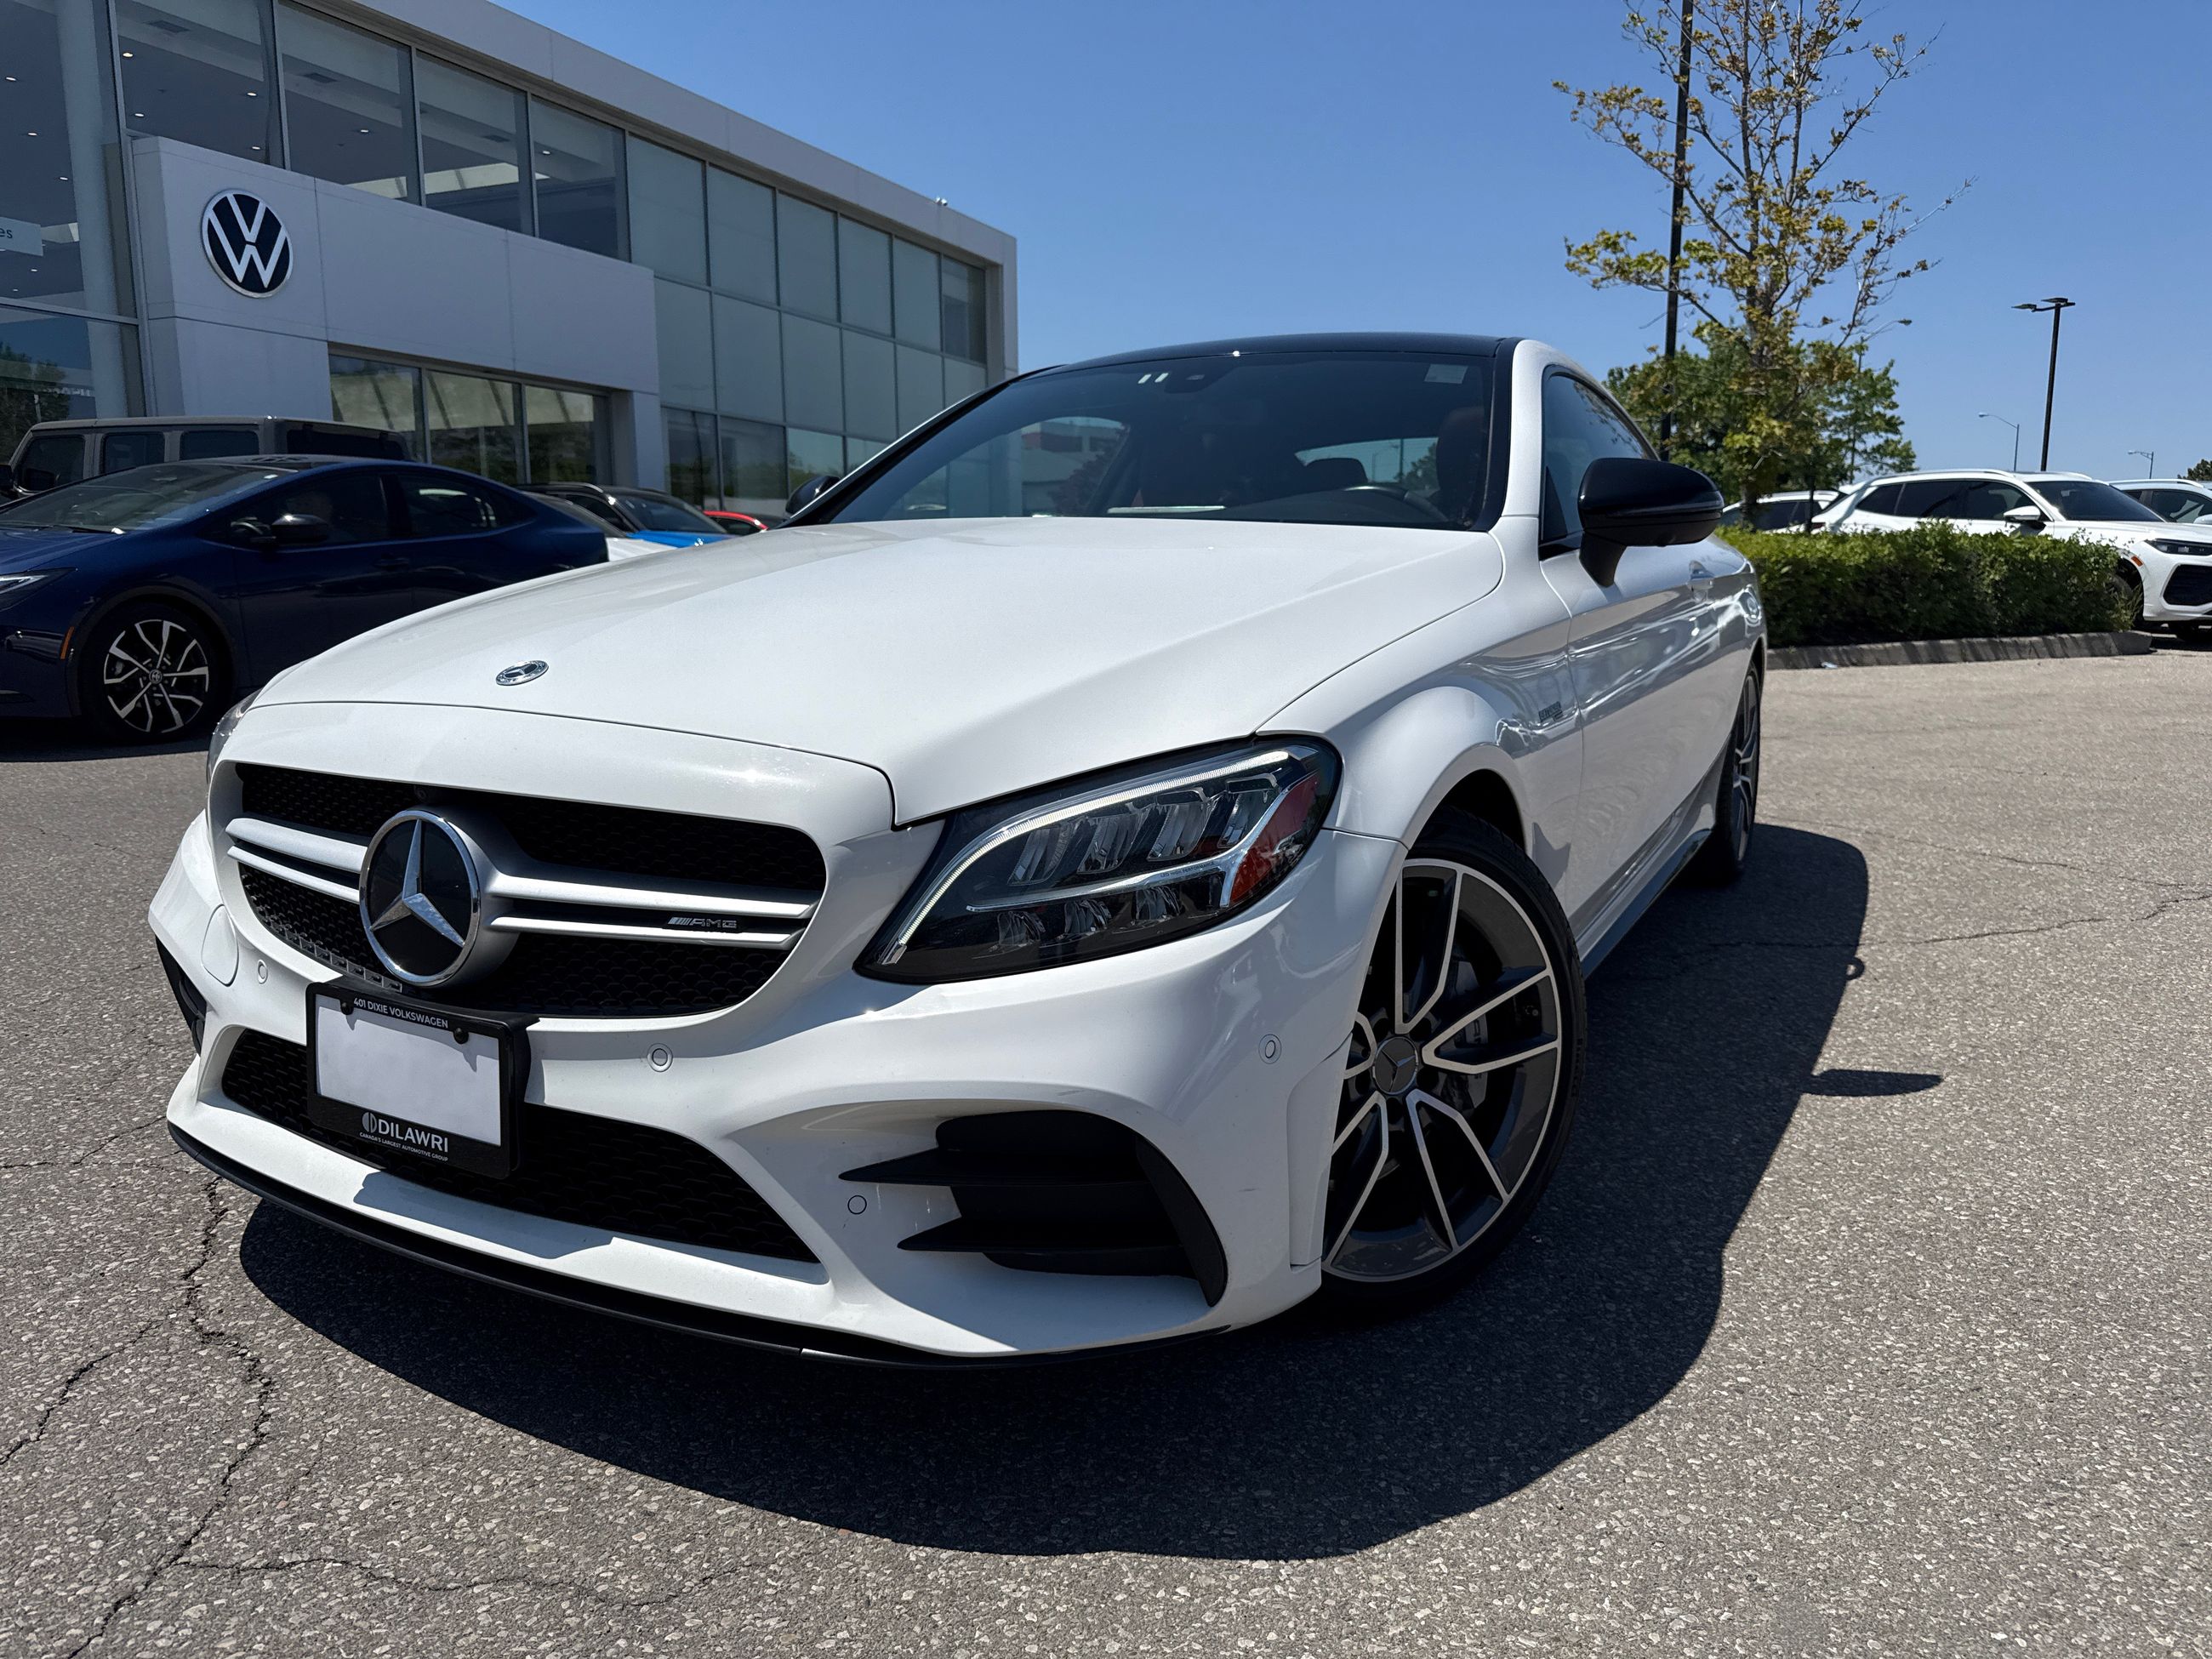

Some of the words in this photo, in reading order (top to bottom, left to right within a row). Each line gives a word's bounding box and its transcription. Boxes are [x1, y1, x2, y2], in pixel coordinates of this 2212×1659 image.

[689, 918, 738, 929] AMG
[354, 998, 367, 1008] 401
[368, 1001, 389, 1014] DIXIE
[389, 1006, 448, 1029] VOLKSWAGEN
[359, 1132, 382, 1143] CANADA'S
[381, 1138, 402, 1149] LARGEST
[402, 1145, 431, 1158] AUTOMOTIVE
[431, 1152, 448, 1162] GROUP
[378, 1118, 448, 1153] DILAWRI
